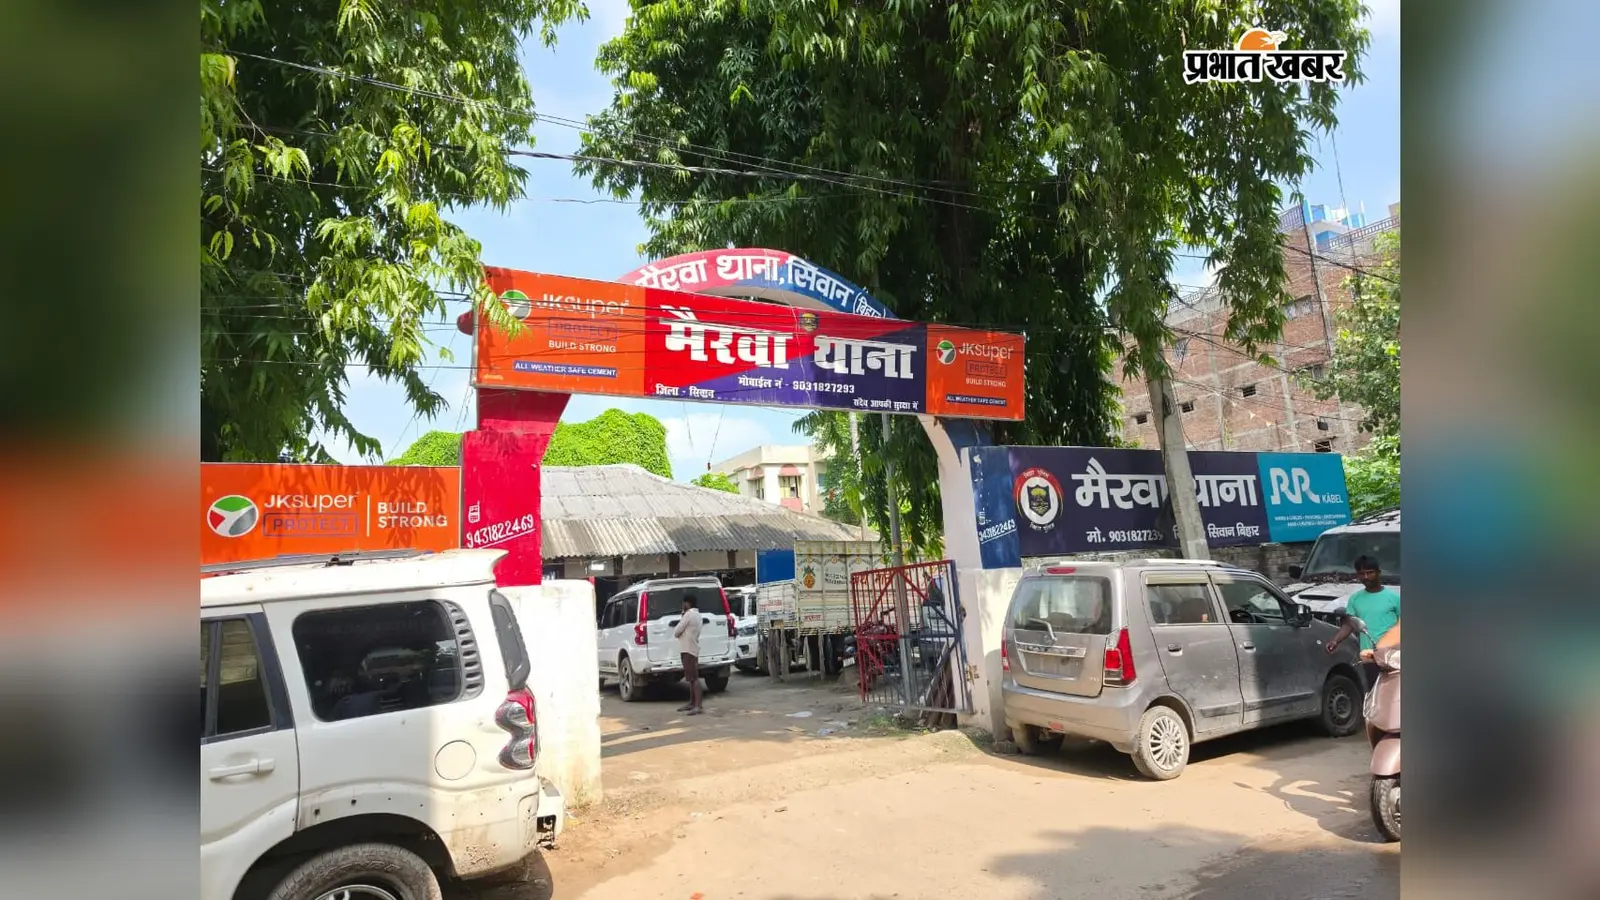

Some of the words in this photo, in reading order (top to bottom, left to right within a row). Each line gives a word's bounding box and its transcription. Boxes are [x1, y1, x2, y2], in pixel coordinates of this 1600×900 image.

[548, 340, 577, 350] BUILD
[579, 343, 616, 353] STRONG
[659, 304, 794, 369] मैरवा
[813, 335, 917, 379] थाना
[531, 364, 566, 373] WEATHER
[567, 366, 586, 374] SAFE
[587, 368, 616, 376] CEMENT
[655, 383, 679, 396] जिला
[792, 380, 855, 394] 9031827293
[1071, 457, 1169, 509] मैरवा
[377, 502, 427, 514] BUILD
[273, 517, 349, 531] PROTECT
[377, 515, 448, 529] STRONG
[466, 514, 534, 548] 9431822469
[1207, 523, 1235, 538] सिवान
[1236, 521, 1260, 538] बिहार
